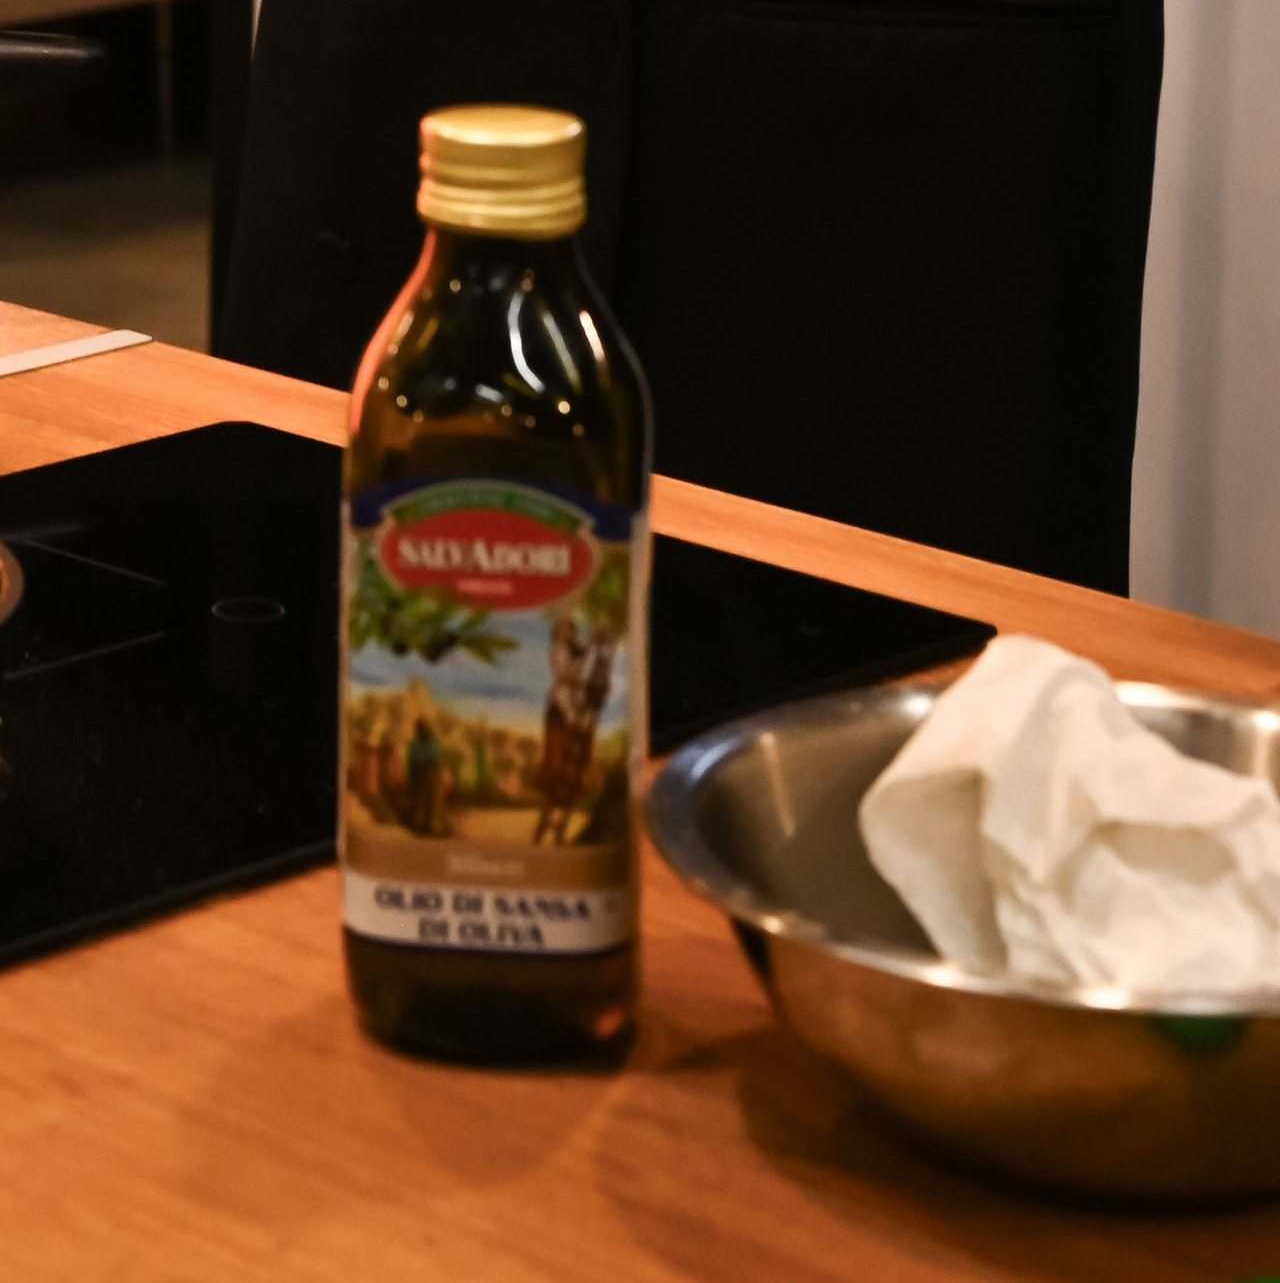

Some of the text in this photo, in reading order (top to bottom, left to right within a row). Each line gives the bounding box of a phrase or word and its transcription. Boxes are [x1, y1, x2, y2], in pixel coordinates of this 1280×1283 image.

[397, 537, 571, 574] SALVADORI
[375, 886, 590, 920] OLIO DI SANSA
[419, 919, 545, 946] DI OLIVA
